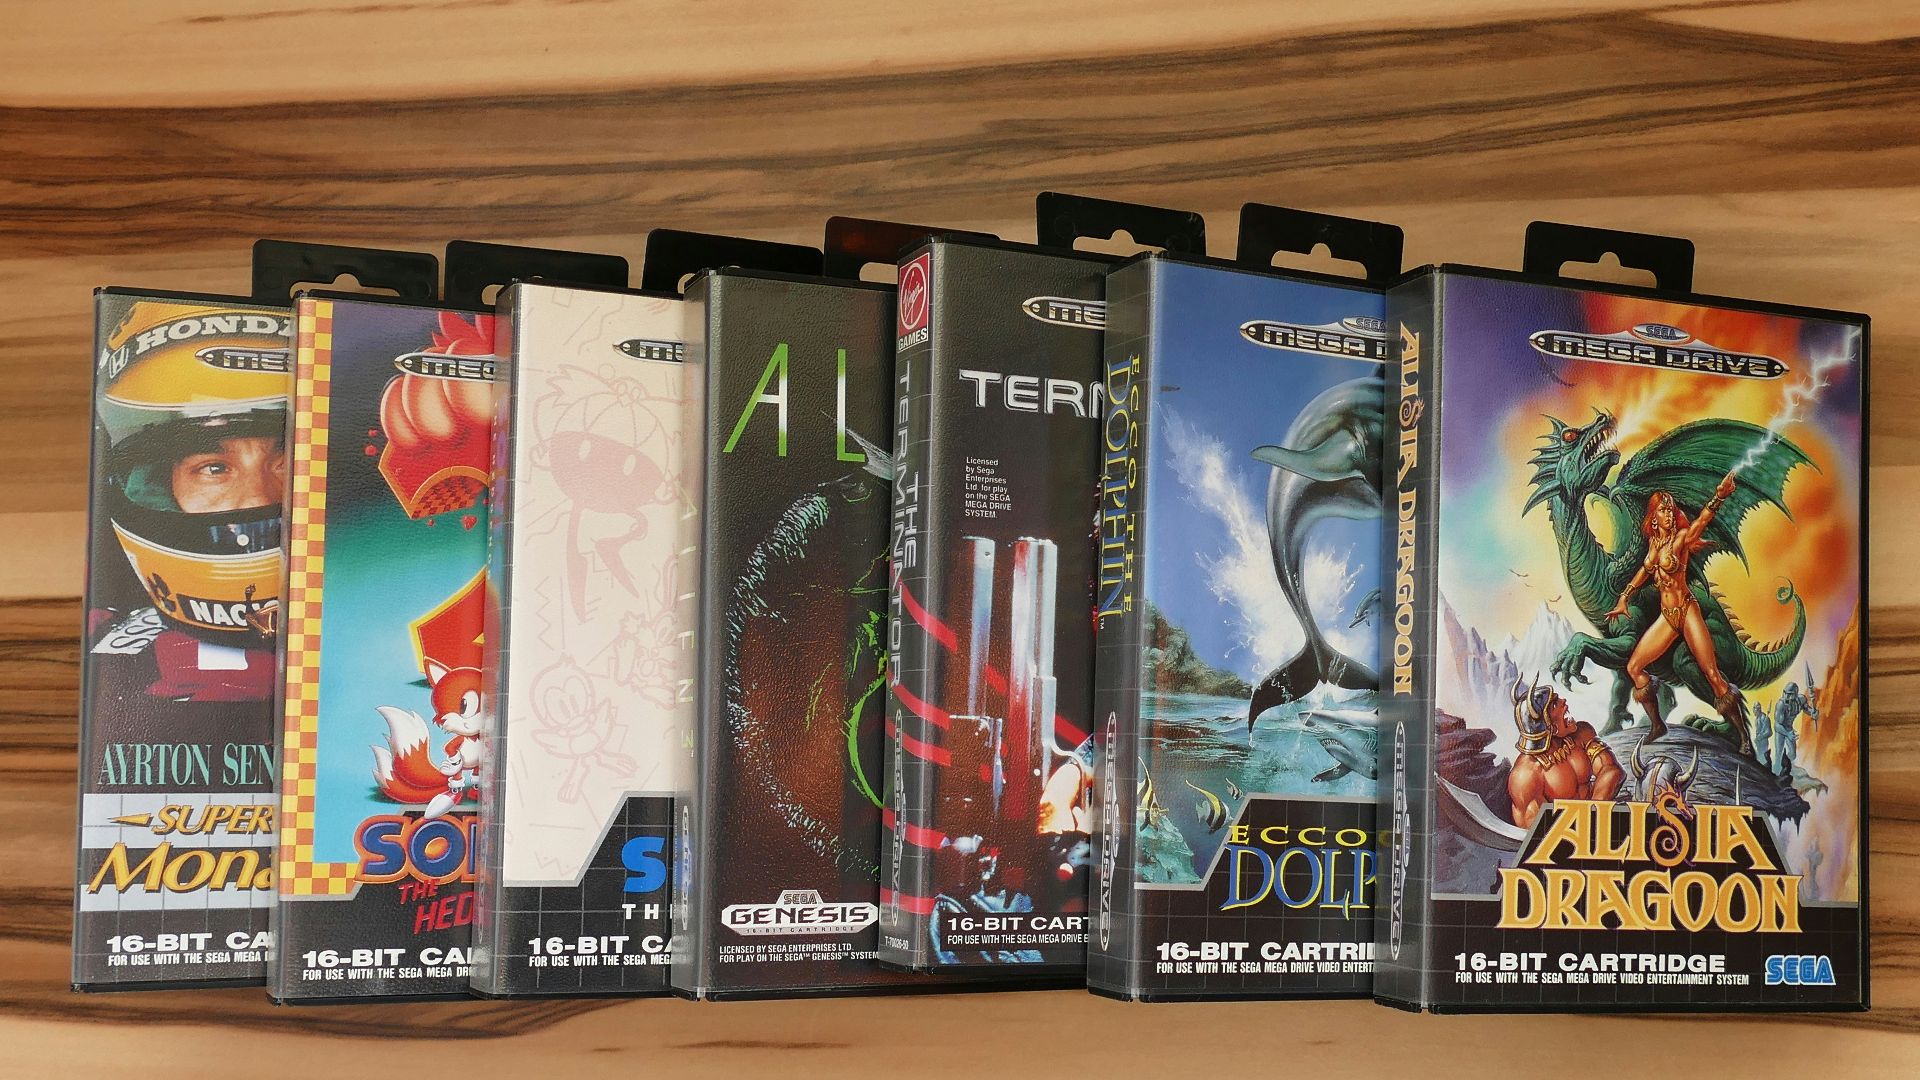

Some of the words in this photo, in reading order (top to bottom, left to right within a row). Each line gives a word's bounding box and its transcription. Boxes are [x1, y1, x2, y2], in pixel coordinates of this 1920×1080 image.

[136, 315, 290, 355] HOND
[898, 327, 928, 351] GAMES
[1263, 325, 1366, 356] MEGA
[1646, 325, 1678, 341] SEGA
[223, 351, 289, 371] ME
[1553, 335, 1656, 364] MEGA
[1666, 348, 1769, 376] DRIVE
[1397, 321, 1424, 488] ALISIA
[1128, 353, 1140, 489] ECCO
[965, 465, 975, 474] by
[976, 466, 995, 476] Sega
[966, 456, 999, 466] Licensed
[965, 474, 1007, 484] Enterprises
[1099, 355, 1131, 618] DOLPHIN
[989, 494, 1011, 502] SEGA
[992, 485, 1008, 495] play
[965, 500, 988, 508] MEGA
[989, 502, 1012, 511] DRIVE
[890, 360, 910, 688] TERMINATOR
[903, 471, 918, 569] THE
[1123, 513, 1136, 612] THE
[1393, 488, 1417, 696] DRAGOON
[97, 742, 212, 786] AYRTON
[151, 804, 274, 835] SUPER
[1523, 786, 1777, 871] ALISIA
[1227, 824, 1367, 847] ECCO
[353, 815, 477, 885] SO
[399, 879, 440, 905] THE
[1219, 844, 1377, 921] DOLP
[783, 893, 817, 905] SEGA
[1495, 867, 1804, 933] DRAGOON
[622, 904, 672, 920] TH
[730, 906, 873, 925] GENESIS
[948, 917, 1023, 931] 16-BIT
[1030, 916, 1088, 931] CAR
[106, 933, 212, 953] 16-BIT
[528, 936, 630, 955] 16-BIT
[719, 945, 755, 954] LICENSED
[756, 945, 767, 953] BY
[768, 944, 787, 953] SEGA
[788, 943, 837, 953] ENTERPRISES
[948, 935, 963, 944] FOR
[965, 935, 979, 944] USE
[981, 935, 1000, 944] WITH
[1001, 934, 1015, 943] THE
[1017, 934, 1037, 943] SEGA
[1039, 934, 1060, 943] MEGA
[1061, 934, 1082, 943] DRIVE
[108, 954, 127, 966] FOR
[131, 954, 151, 965] USE
[154, 953, 180, 965] WITH
[184, 953, 202, 964] THE
[206, 952, 230, 963] SEGA
[234, 951, 261, 963] MEGA
[302, 949, 406, 967] 16-BIT
[419, 947, 473, 965] CA
[529, 956, 547, 966] FOR
[552, 956, 570, 966] USE
[573, 955, 598, 966] WITH
[602, 955, 619, 965] THE
[623, 955, 647, 965] SEGA
[650, 954, 672, 965] MEG
[719, 955, 735, 963] FOR
[736, 954, 756, 963] PLAY
[757, 954, 768, 962] ON
[769, 954, 783, 962] THE
[1157, 942, 1250, 960] 16-BIT
[1156, 962, 1173, 973] FOR
[1176, 962, 1192, 973] USE
[1196, 962, 1218, 973] WITH
[1221, 962, 1237, 973] THE
[1240, 962, 1261, 973] SEGA
[1264, 962, 1287, 973] MEGA
[1291, 962, 1314, 973] DRIVE
[1317, 962, 1340, 973] VIDEO
[1343, 962, 1374, 973] ENTERT
[1454, 952, 1548, 971] 16-BIT
[1558, 953, 1726, 972] CARTRIDGE
[1764, 955, 1837, 986] SEGA
[303, 969, 321, 980] FOR
[326, 969, 344, 980] USE
[348, 968, 373, 979] WITH
[377, 968, 395, 979] THE
[399, 967, 423, 978] SEGA
[427, 967, 452, 978] MEGA
[1455, 972, 1472, 983] FOR
[1475, 972, 1492, 983] USE
[1495, 972, 1518, 983] WITH
[1522, 972, 1538, 983] THE
[1541, 973, 1563, 984] SEGA
[1566, 973, 1589, 984] MEGA
[1593, 973, 1616, 984] DRIVE
[1620, 973, 1644, 984] VIDEO
[1647, 973, 1714, 984] ENTERTAINMENT
[1716, 974, 1749, 985] SYSTEM
